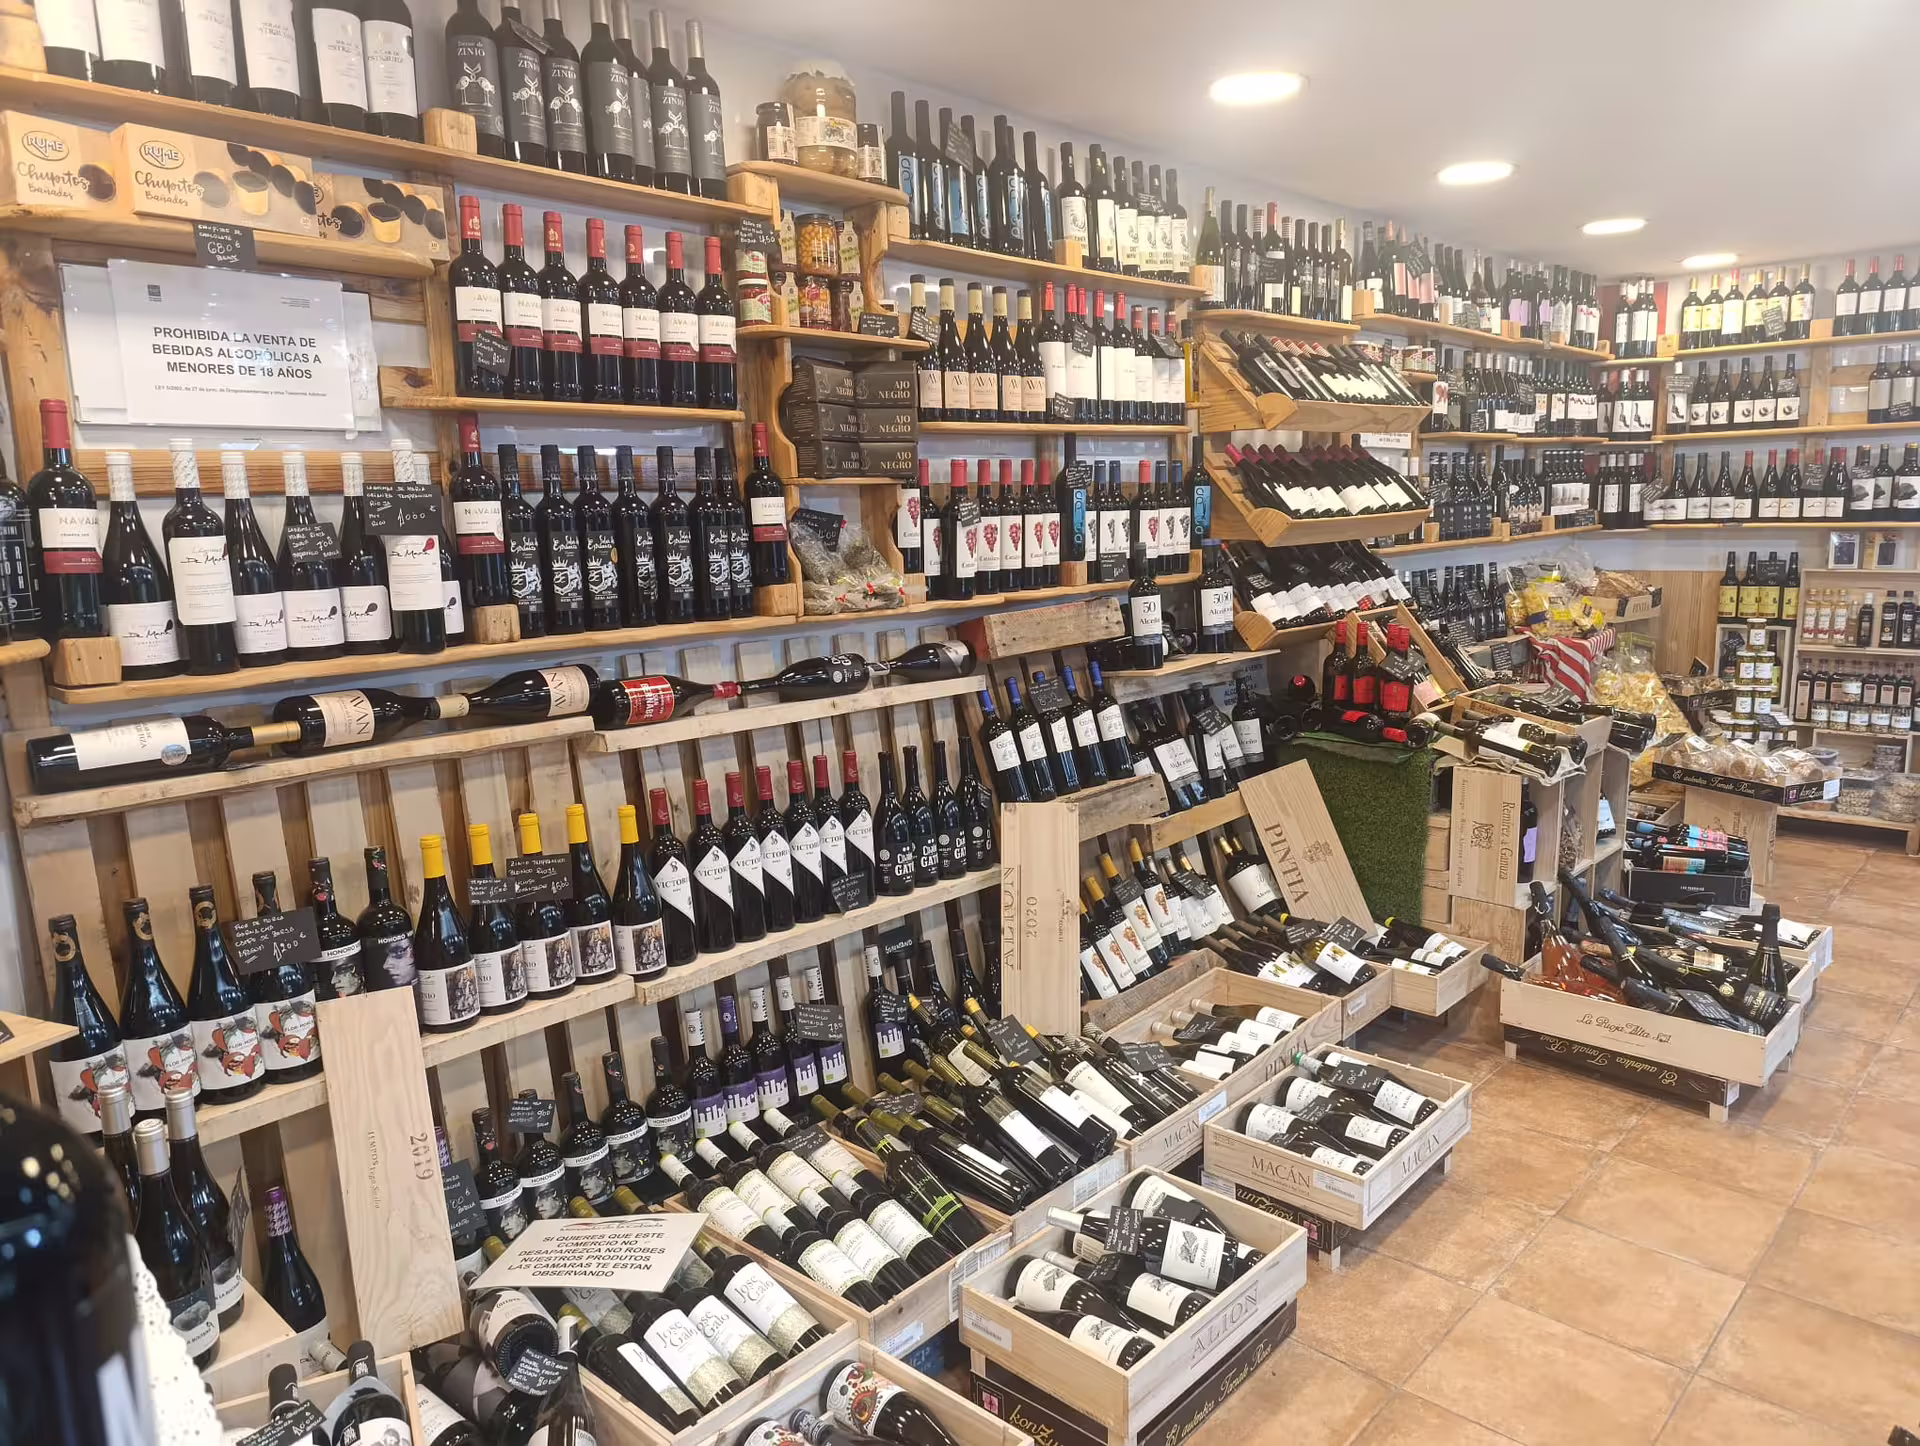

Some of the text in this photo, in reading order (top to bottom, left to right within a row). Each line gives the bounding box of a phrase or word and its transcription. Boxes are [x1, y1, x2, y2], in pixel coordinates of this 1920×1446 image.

[457, 47, 485, 57] ZINIO
[551, 69, 576, 79] ZINIO
[26, 135, 65, 157] RUME
[143, 144, 179, 165] RUME
[17, 162, 89, 190] Chupitos
[135, 171, 204, 196] Chupitos
[28, 184, 73, 199] Bañados
[145, 191, 189, 206] Bañados
[153, 326, 317, 348] PROHIBIDA LA VENTA DE
[152, 344, 322, 364] BEBIDAS ALCOHÓLICAS A
[166, 361, 313, 380] MENORES DE 18 AÑOS
[843, 378, 853, 387] AJO
[894, 380, 911, 389] AJO
[835, 386, 854, 397] NEGRO
[878, 390, 911, 399] NEGRO
[894, 415, 911, 424] AJO
[879, 424, 912, 433] NEGRO
[895, 451, 912, 460] AJO
[880, 460, 912, 469] NEGRO
[1142, 600, 1156, 614] 50
[1263, 822, 1310, 905] PINTIA
[1499, 847, 1514, 880] Ganuza
[1026, 896, 1038, 939] 2020
[378, 934, 406, 945] HONORO
[327, 945, 353, 957] HONORO
[1576, 1013, 1650, 1039] La Rioja Alta
[1539, 1034, 1678, 1087] El Tomate Rosa
[652, 1116, 677, 1125] HONORO
[409, 1132, 435, 1181] 2019
[575, 1151, 600, 1164] HONORO
[530, 1170, 557, 1184] HONORO
[1251, 1155, 1312, 1189] MACÁN
[556, 1233, 605, 1242] QUIERES
[557, 1240, 618, 1248] COMERCIO
[518, 1248, 602, 1257] DESAPAREZCA
[625, 1247, 666, 1255] ROBES
[520, 1255, 584, 1263] NUESTROS
[507, 1263, 531, 1271] LAS
[534, 1262, 593, 1270] CAMARAS
[612, 1263, 653, 1271] ESTAN
[531, 1270, 615, 1278] OBSERVANDO
[734, 1271, 760, 1304] Jose
[749, 1279, 775, 1304] Galo
[704, 1313, 730, 1340] Galo
[1191, 1287, 1259, 1360] ALION
[655, 1321, 683, 1348] Jose
[1218, 1363, 1249, 1402] Tomate
[1009, 1404, 1064, 1446] konZu
